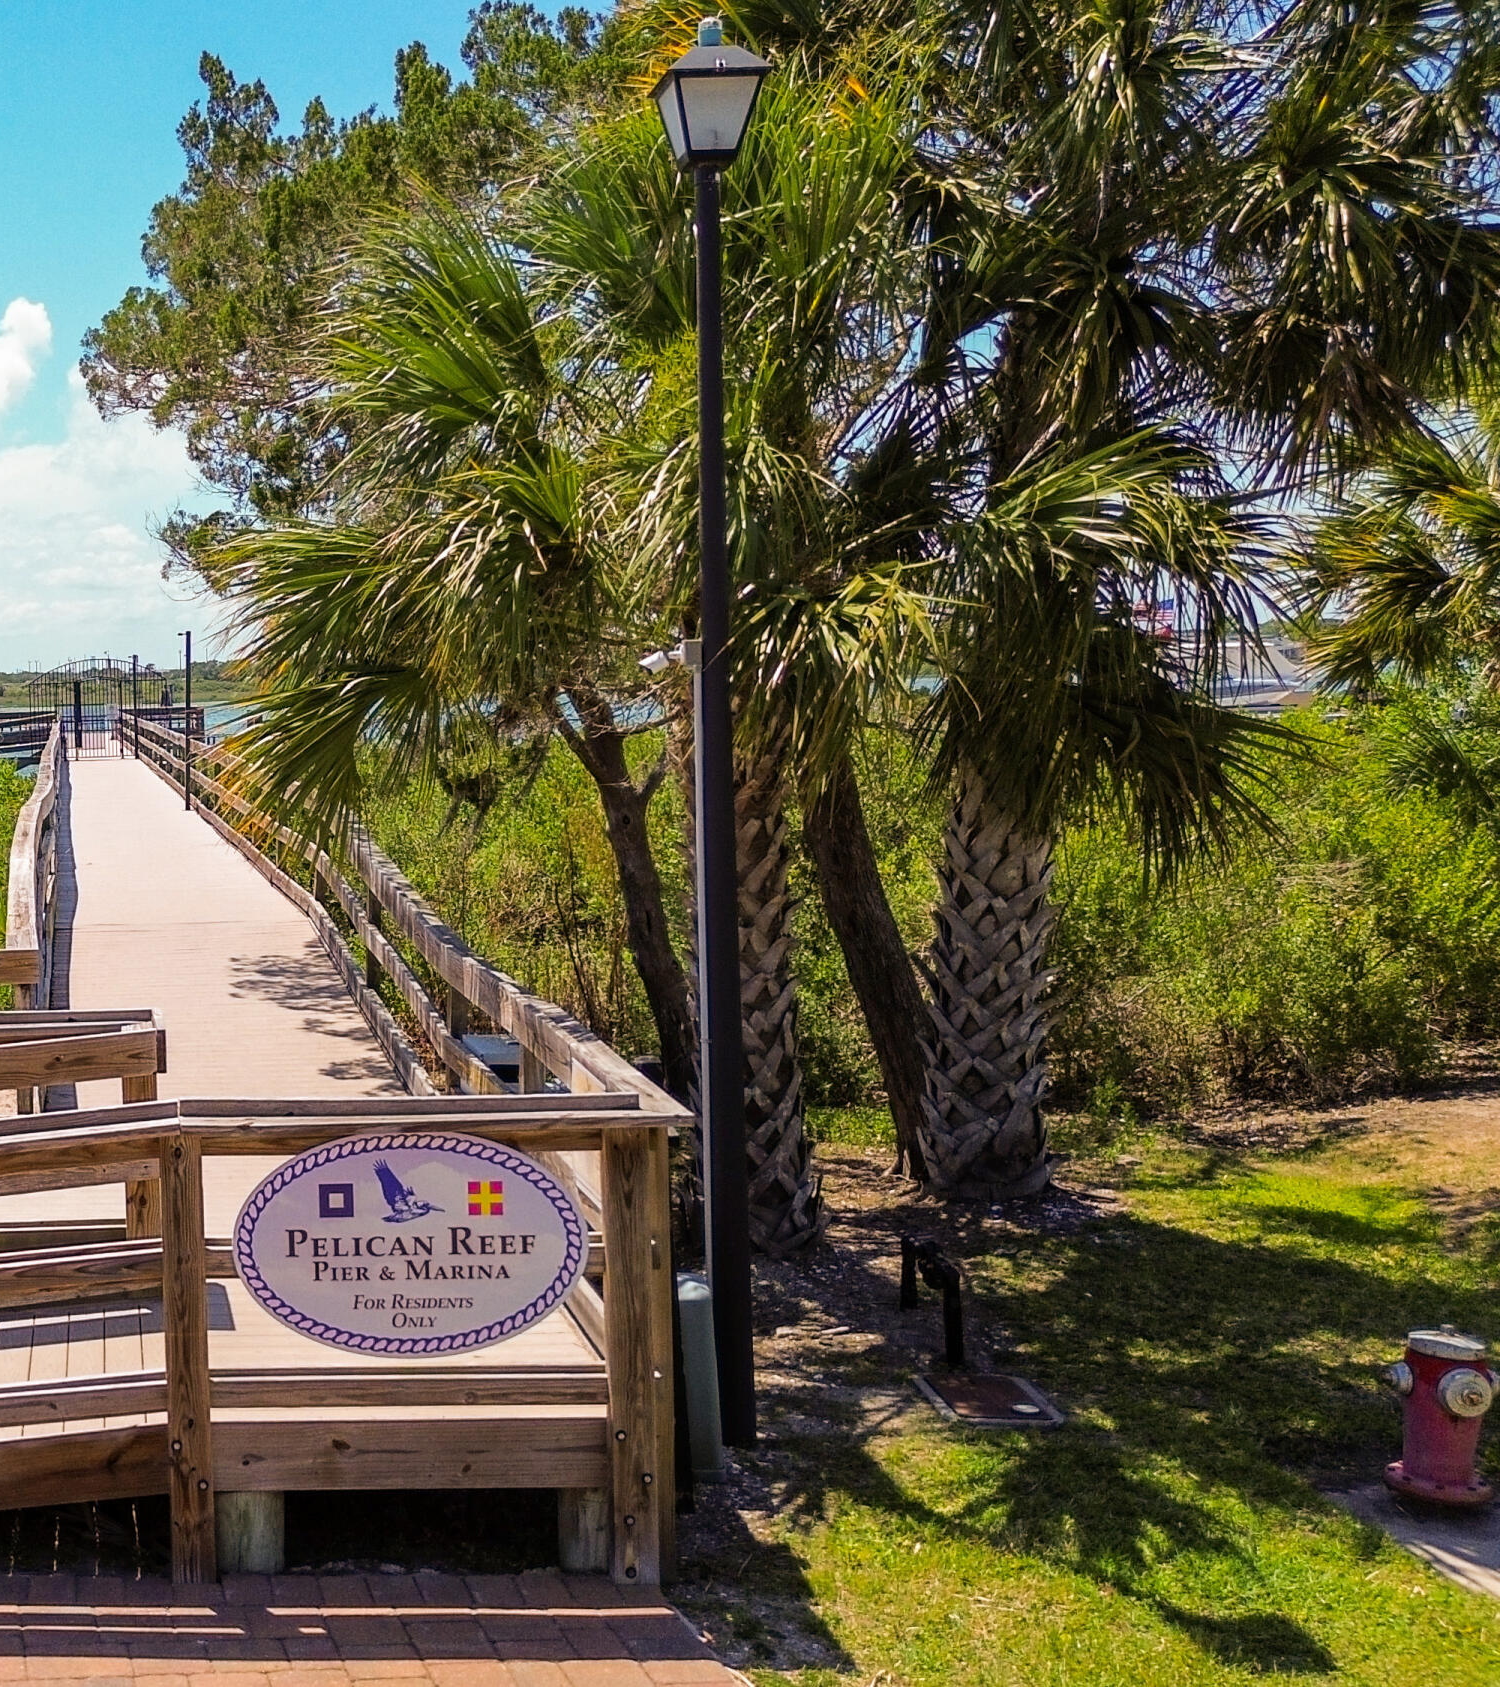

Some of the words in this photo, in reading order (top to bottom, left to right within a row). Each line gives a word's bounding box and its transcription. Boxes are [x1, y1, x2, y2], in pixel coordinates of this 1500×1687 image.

[285, 1229, 434, 1258] PELICAN
[447, 1226, 536, 1255] REEF
[312, 1261, 371, 1281] PIER
[379, 1265, 396, 1281] &
[405, 1260, 511, 1280] MARINA
[353, 1294, 386, 1310] FOR
[391, 1294, 474, 1309] RESIDENTS
[391, 1312, 437, 1328] ONLY
